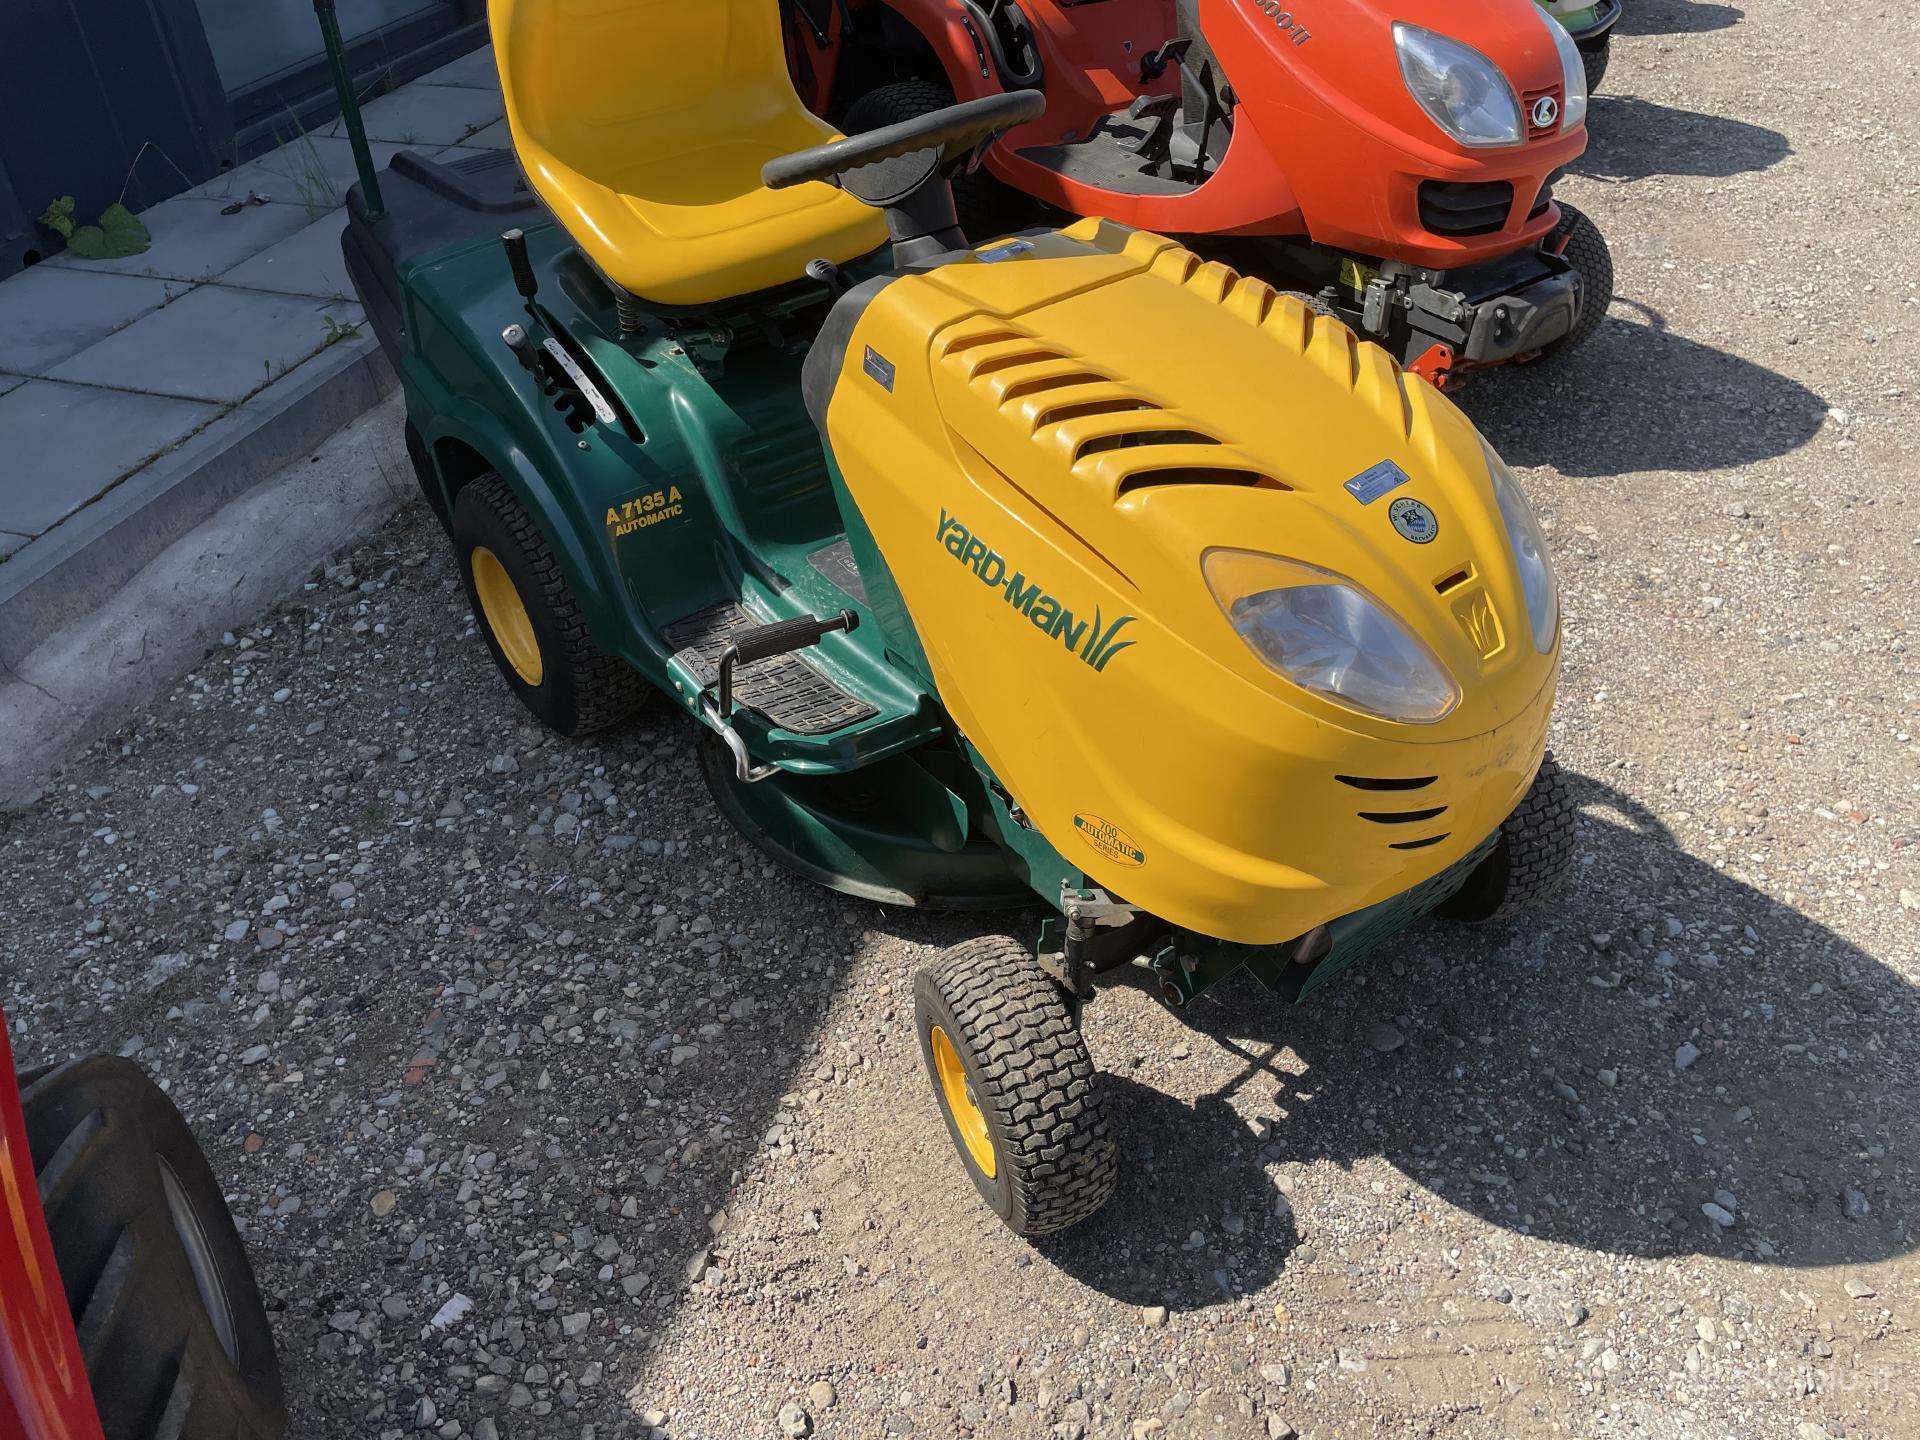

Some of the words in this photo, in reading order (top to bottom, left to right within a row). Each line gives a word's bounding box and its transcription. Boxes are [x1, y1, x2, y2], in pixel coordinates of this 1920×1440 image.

[606, 507, 621, 525] A
[621, 490, 666, 519] 7135
[668, 485, 682, 503] A
[615, 504, 683, 537] AUTOMATIC
[1080, 820, 1137, 858] AUTOMATIC
[1099, 819, 1118, 837] 700
[1093, 838, 1120, 859] SERIES
